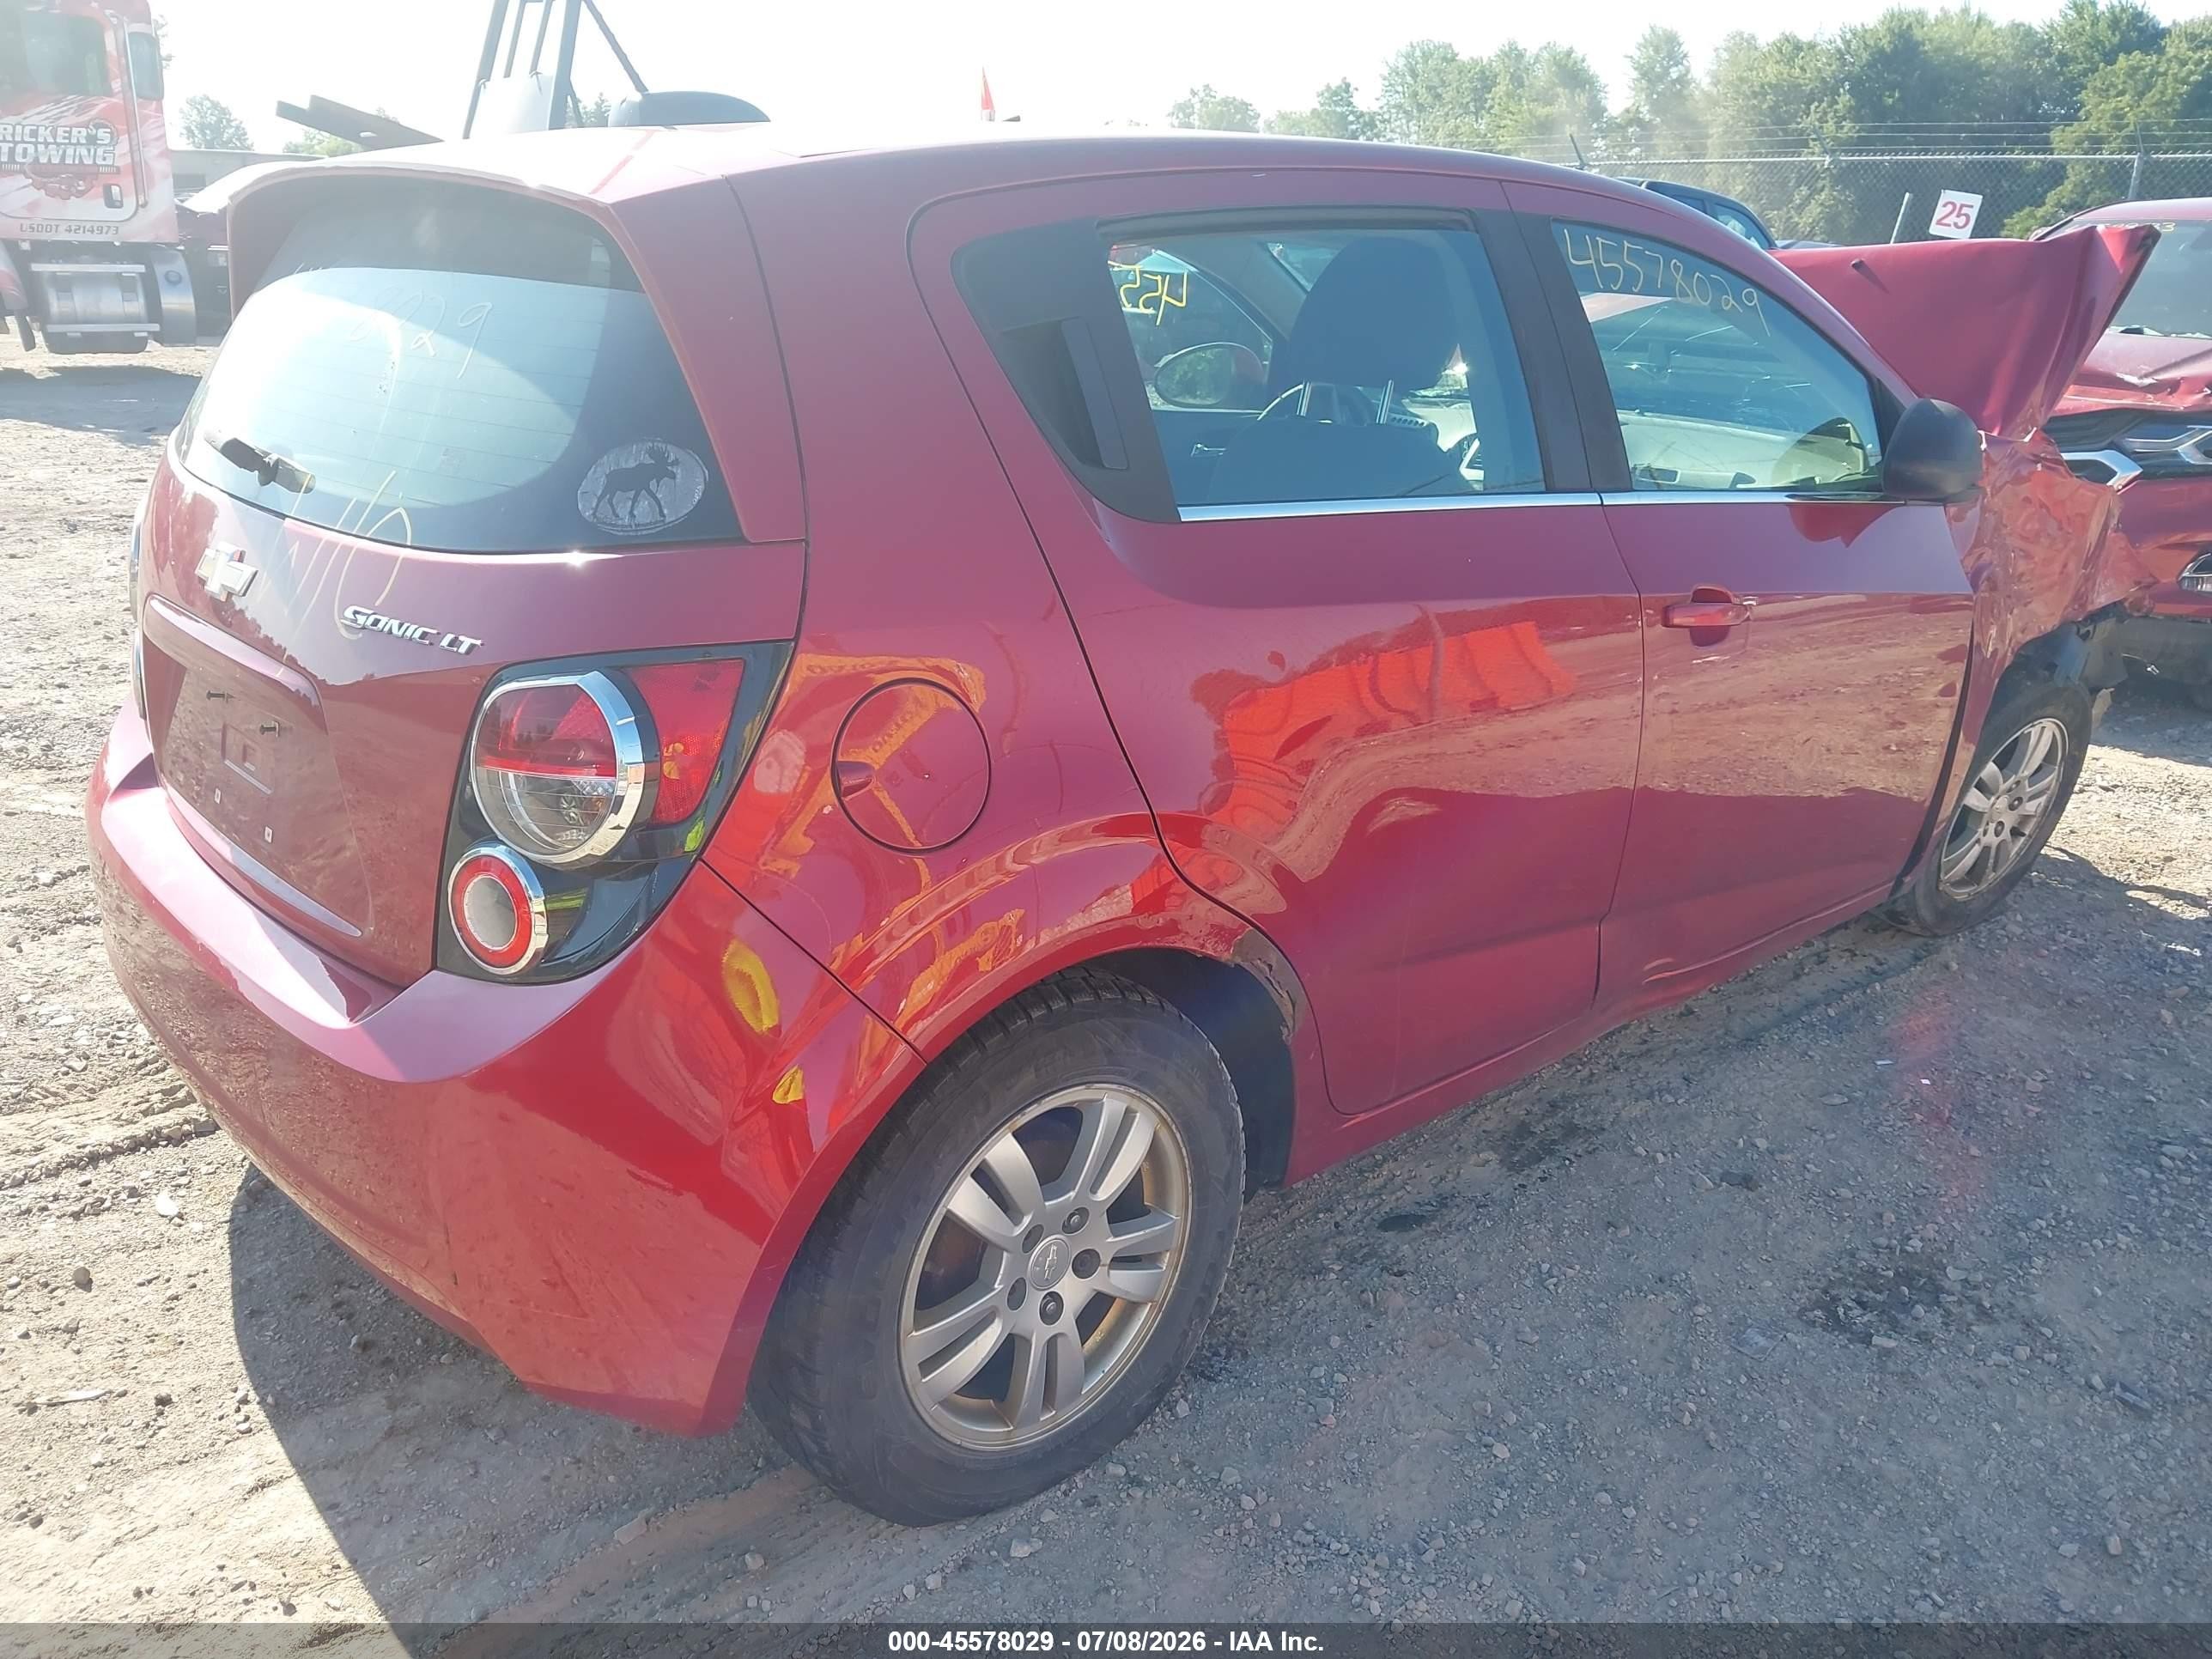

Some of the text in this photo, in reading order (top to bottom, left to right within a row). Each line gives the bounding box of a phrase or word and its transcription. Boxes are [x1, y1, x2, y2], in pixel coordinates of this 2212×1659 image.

[0, 123, 111, 144] RICKER'S
[0, 143, 116, 165] TOWING
[1936, 201, 1974, 229] 25
[20, 223, 60, 233] USDOT
[1564, 228, 1771, 337] 45578029
[340, 605, 484, 655] SONIC LT
